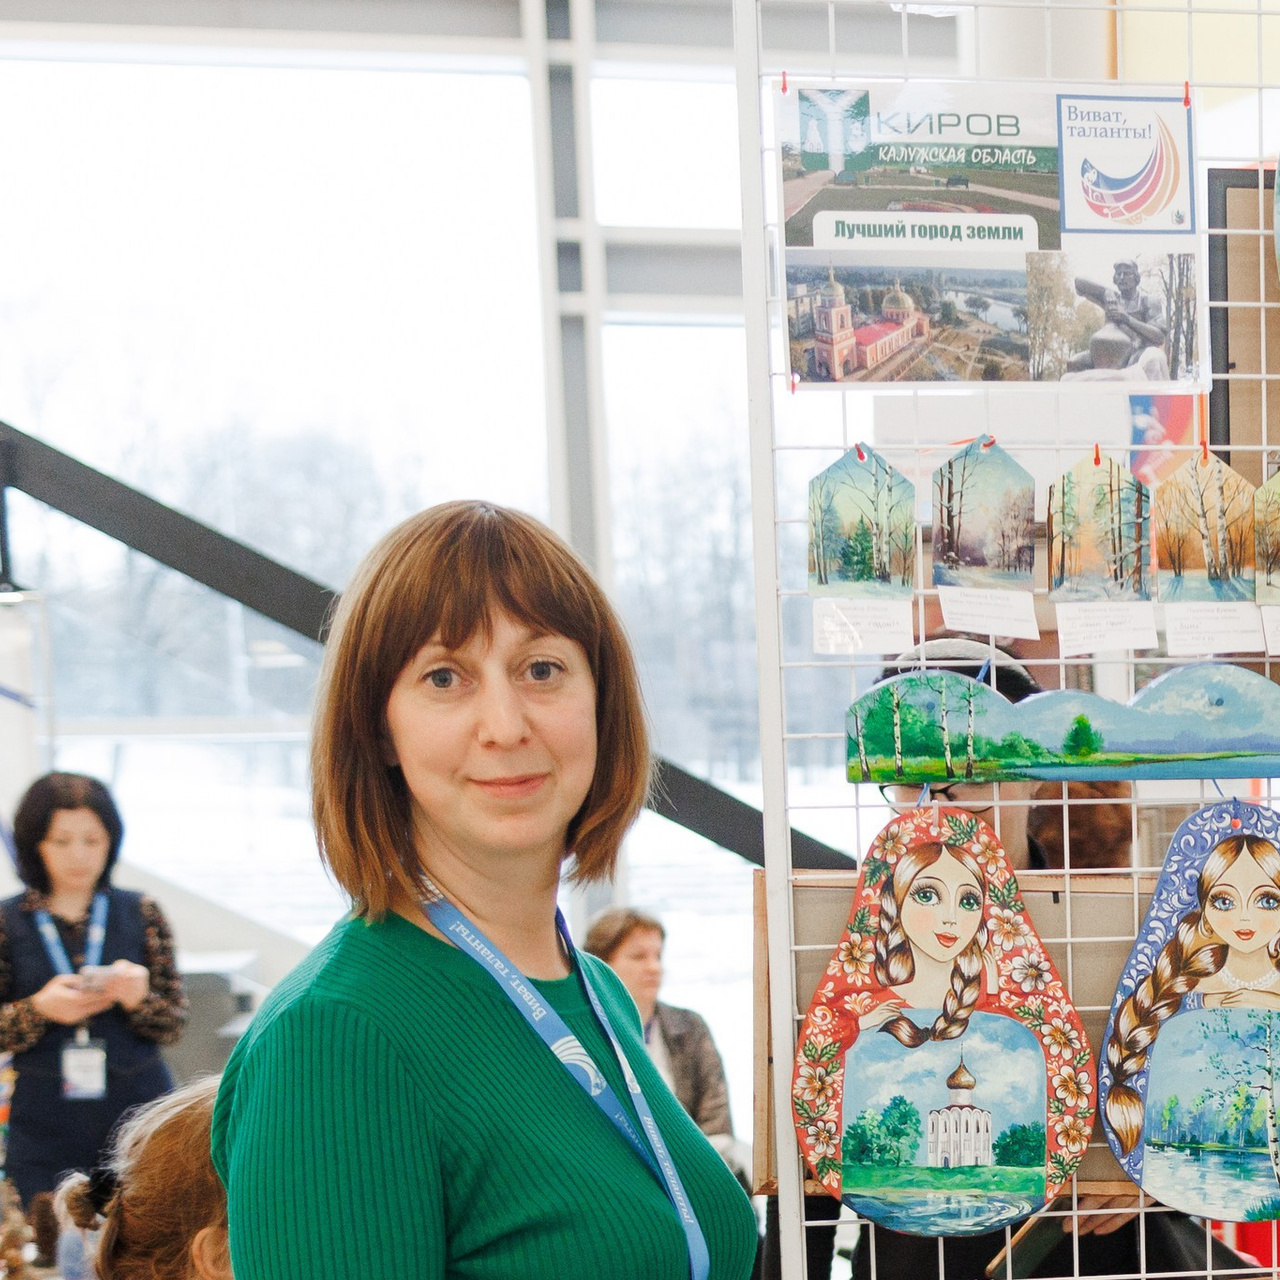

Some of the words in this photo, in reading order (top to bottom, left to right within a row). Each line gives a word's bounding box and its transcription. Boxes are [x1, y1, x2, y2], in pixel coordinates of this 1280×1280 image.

[877, 111, 1021, 137] КИРОВ
[1066, 104, 1128, 126] Виват,
[1066, 123, 1153, 140] таланты!
[878, 145, 966, 164] КАЛУЖСКАЯ
[970, 148, 1037, 166] ОБЛАСТЬ
[834, 219, 906, 239] Лучший
[910, 223, 963, 242] город
[966, 224, 1024, 241] земли
[448, 920, 510, 978] таланты!
[509, 974, 548, 1022] Виват,
